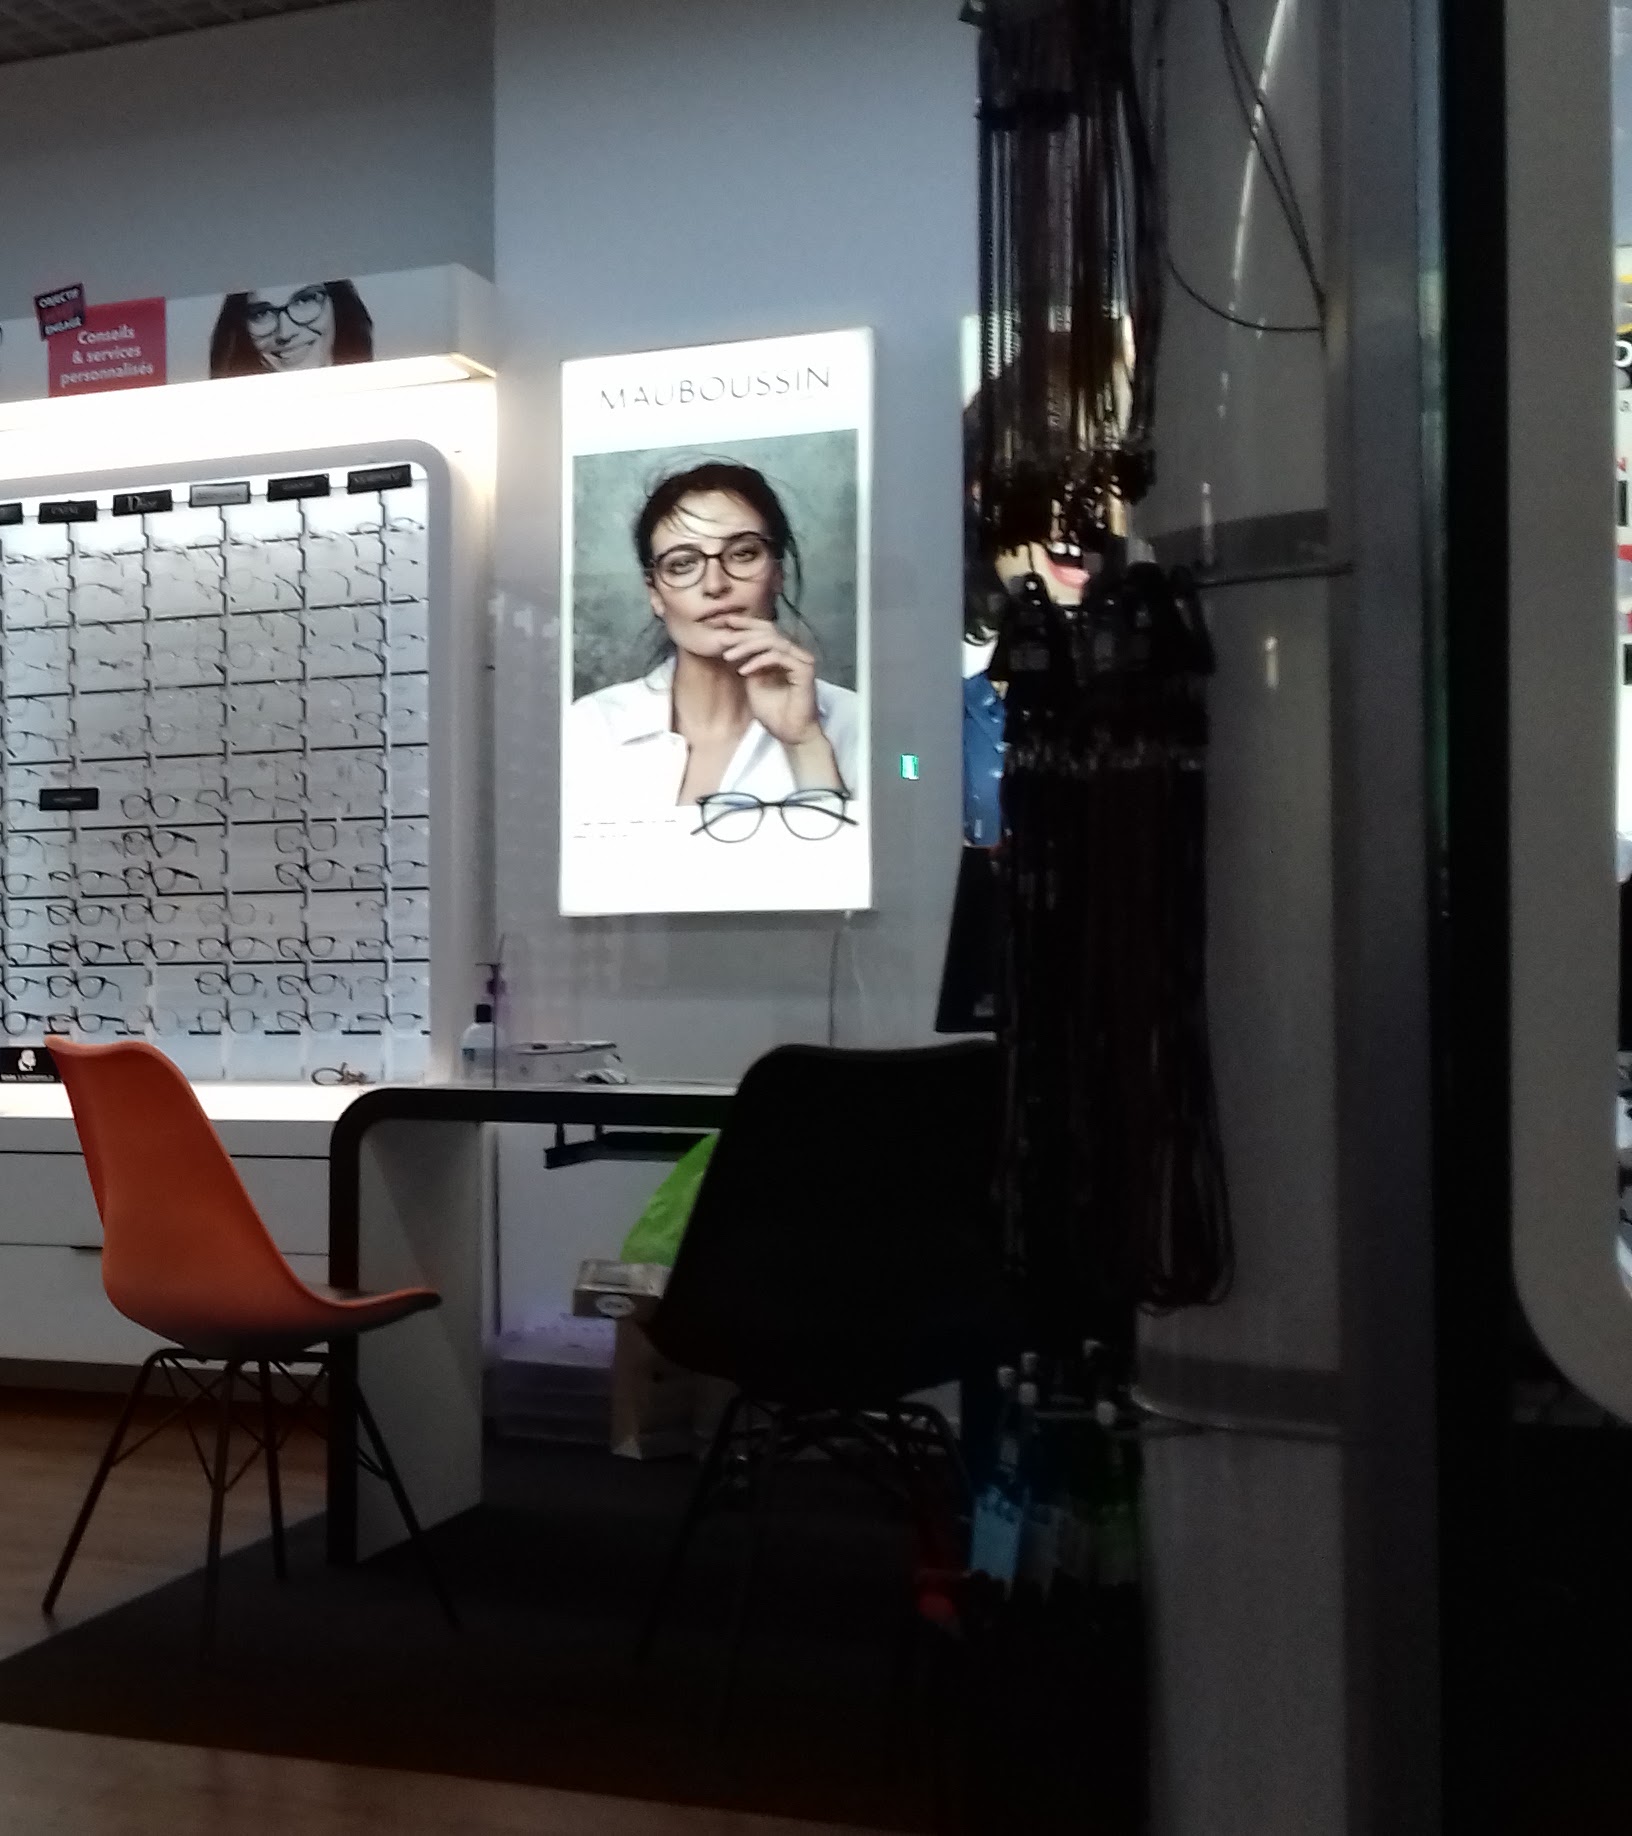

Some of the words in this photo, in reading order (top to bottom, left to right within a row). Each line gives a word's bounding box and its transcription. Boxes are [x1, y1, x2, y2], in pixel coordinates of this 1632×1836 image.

[76, 323, 136, 345] Conseils
[71, 350, 84, 365] &
[85, 345, 143, 363] services
[59, 361, 155, 389] personnalisés
[600, 365, 830, 410] MAUBOUSSIN
